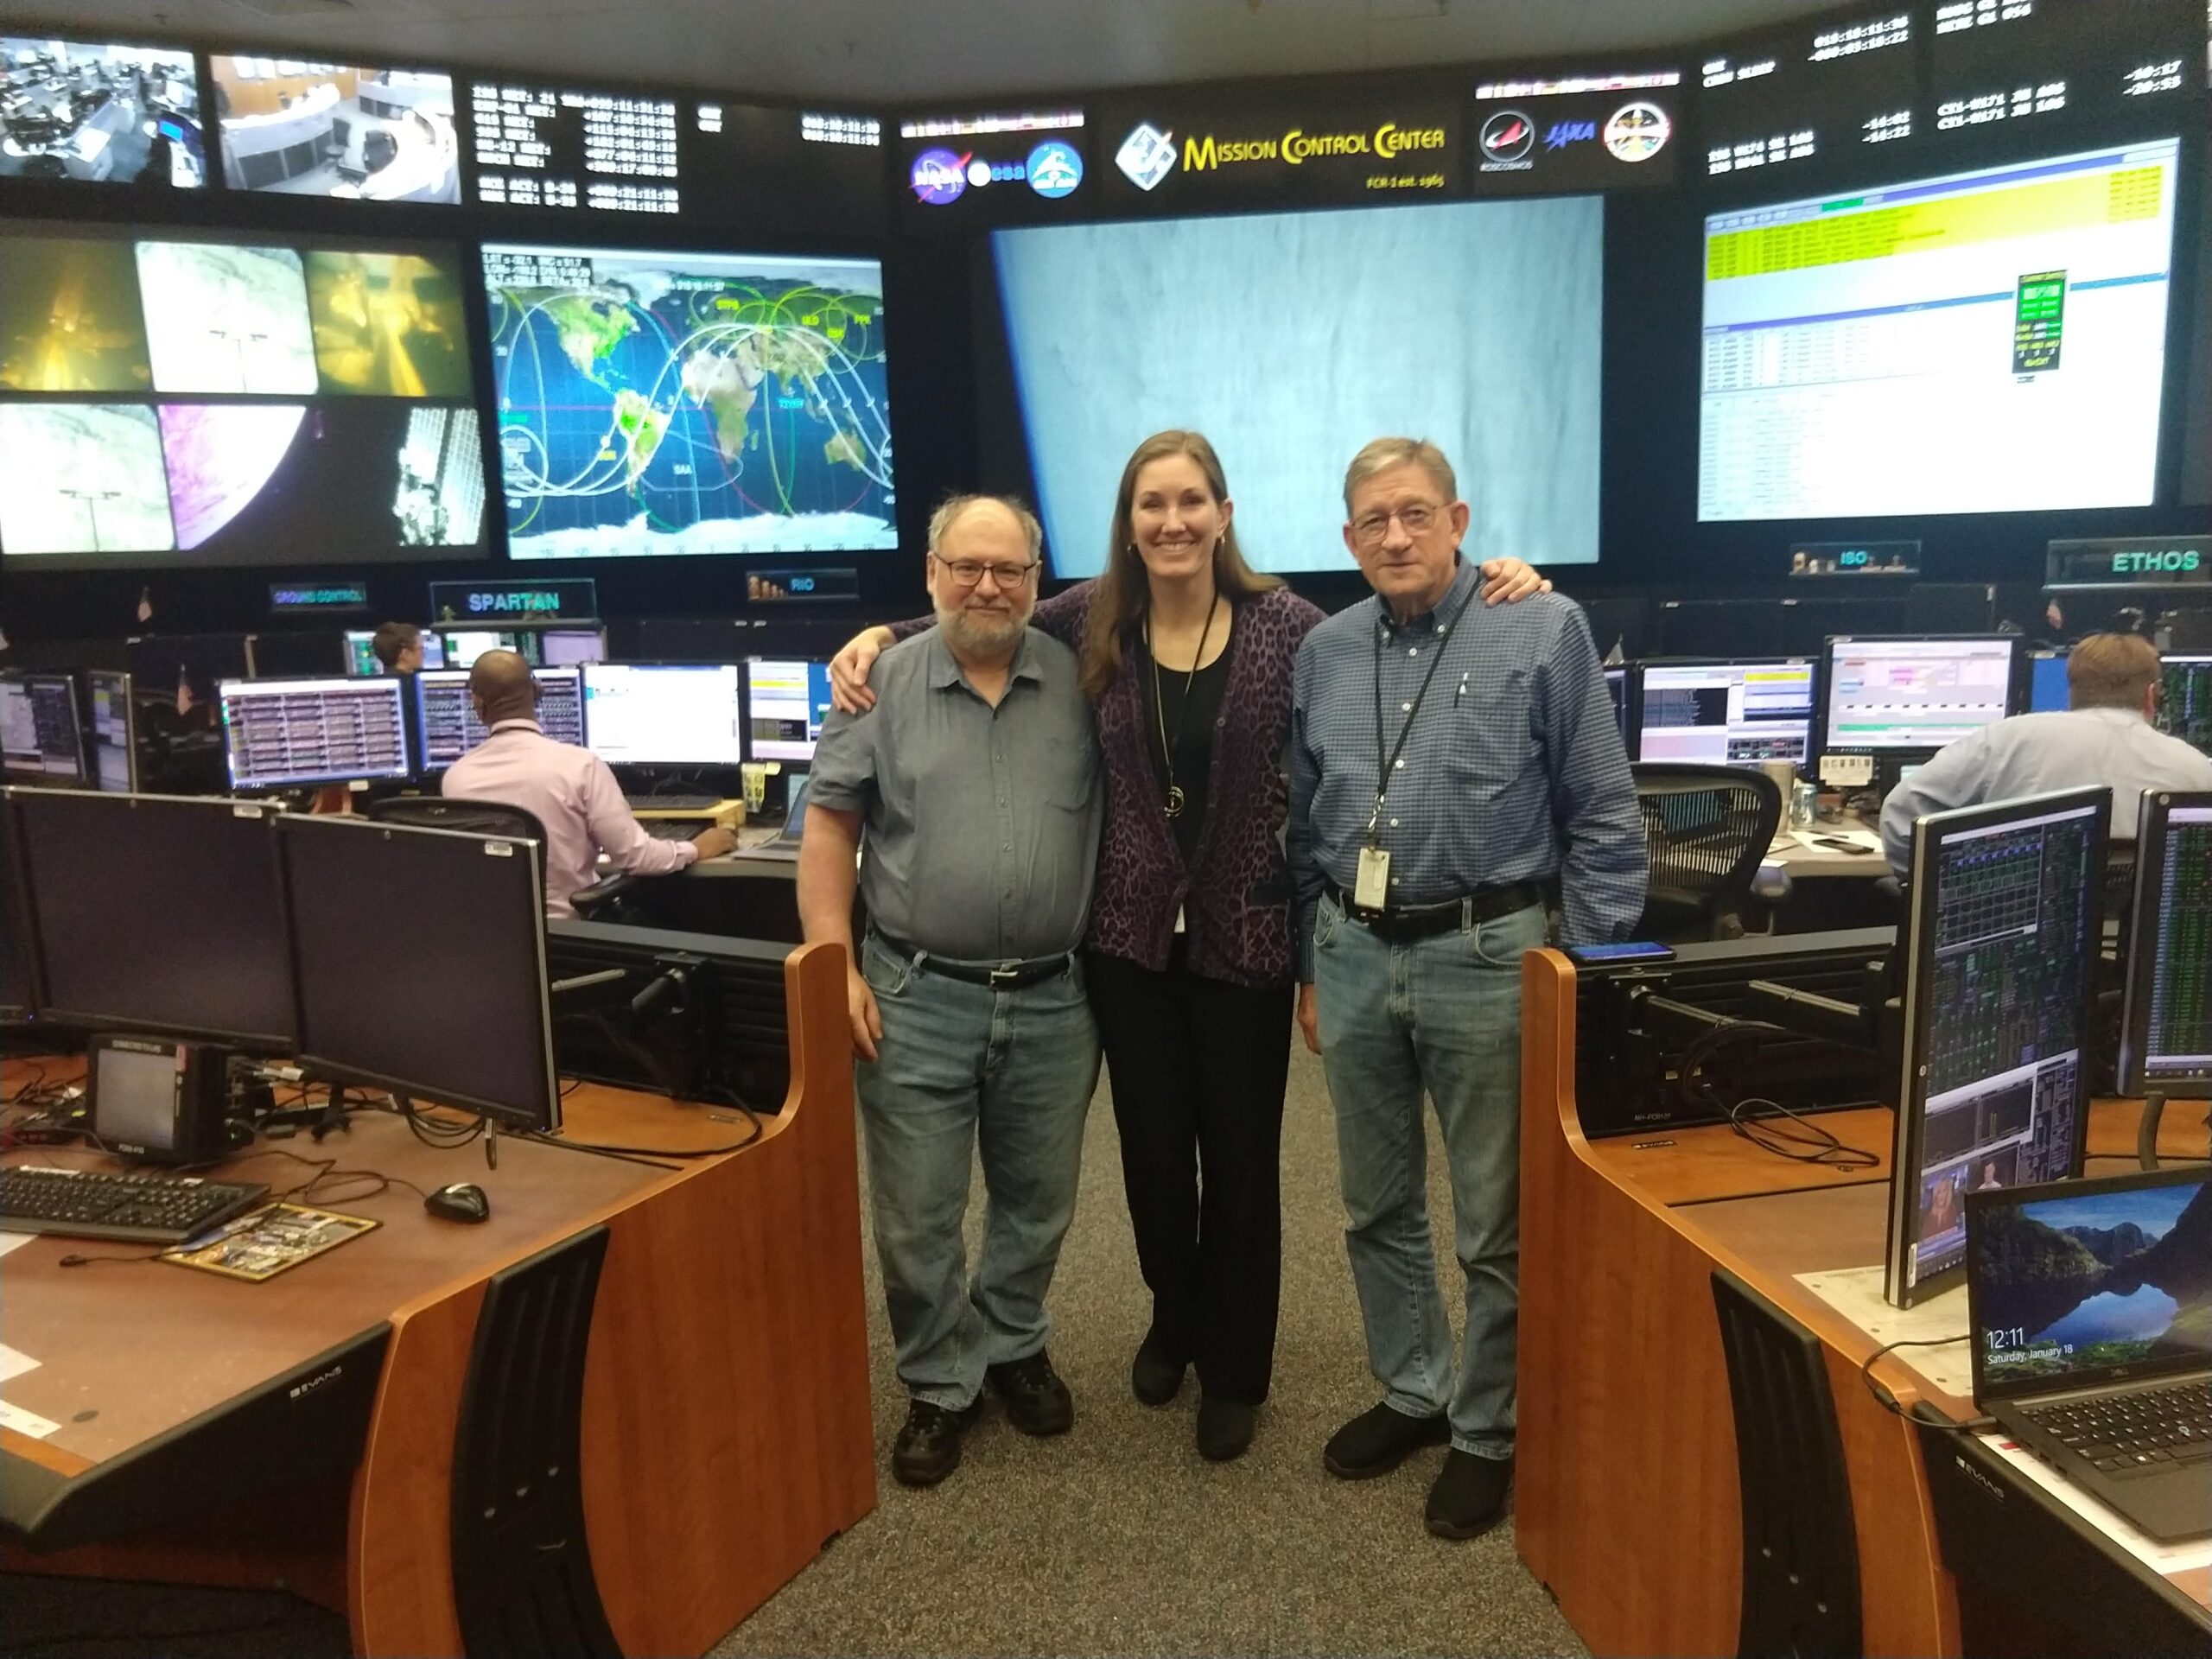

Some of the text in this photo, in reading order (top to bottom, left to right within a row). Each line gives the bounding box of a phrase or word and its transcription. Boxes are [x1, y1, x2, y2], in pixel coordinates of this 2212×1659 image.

[2113, 550, 2200, 572] ETHOS
[791, 578, 814, 592] RIO
[468, 592, 560, 612] SPARTAN
[1986, 1326, 2024, 1350] 12:11
[1987, 1344, 2074, 1365] Saturday, January 18
